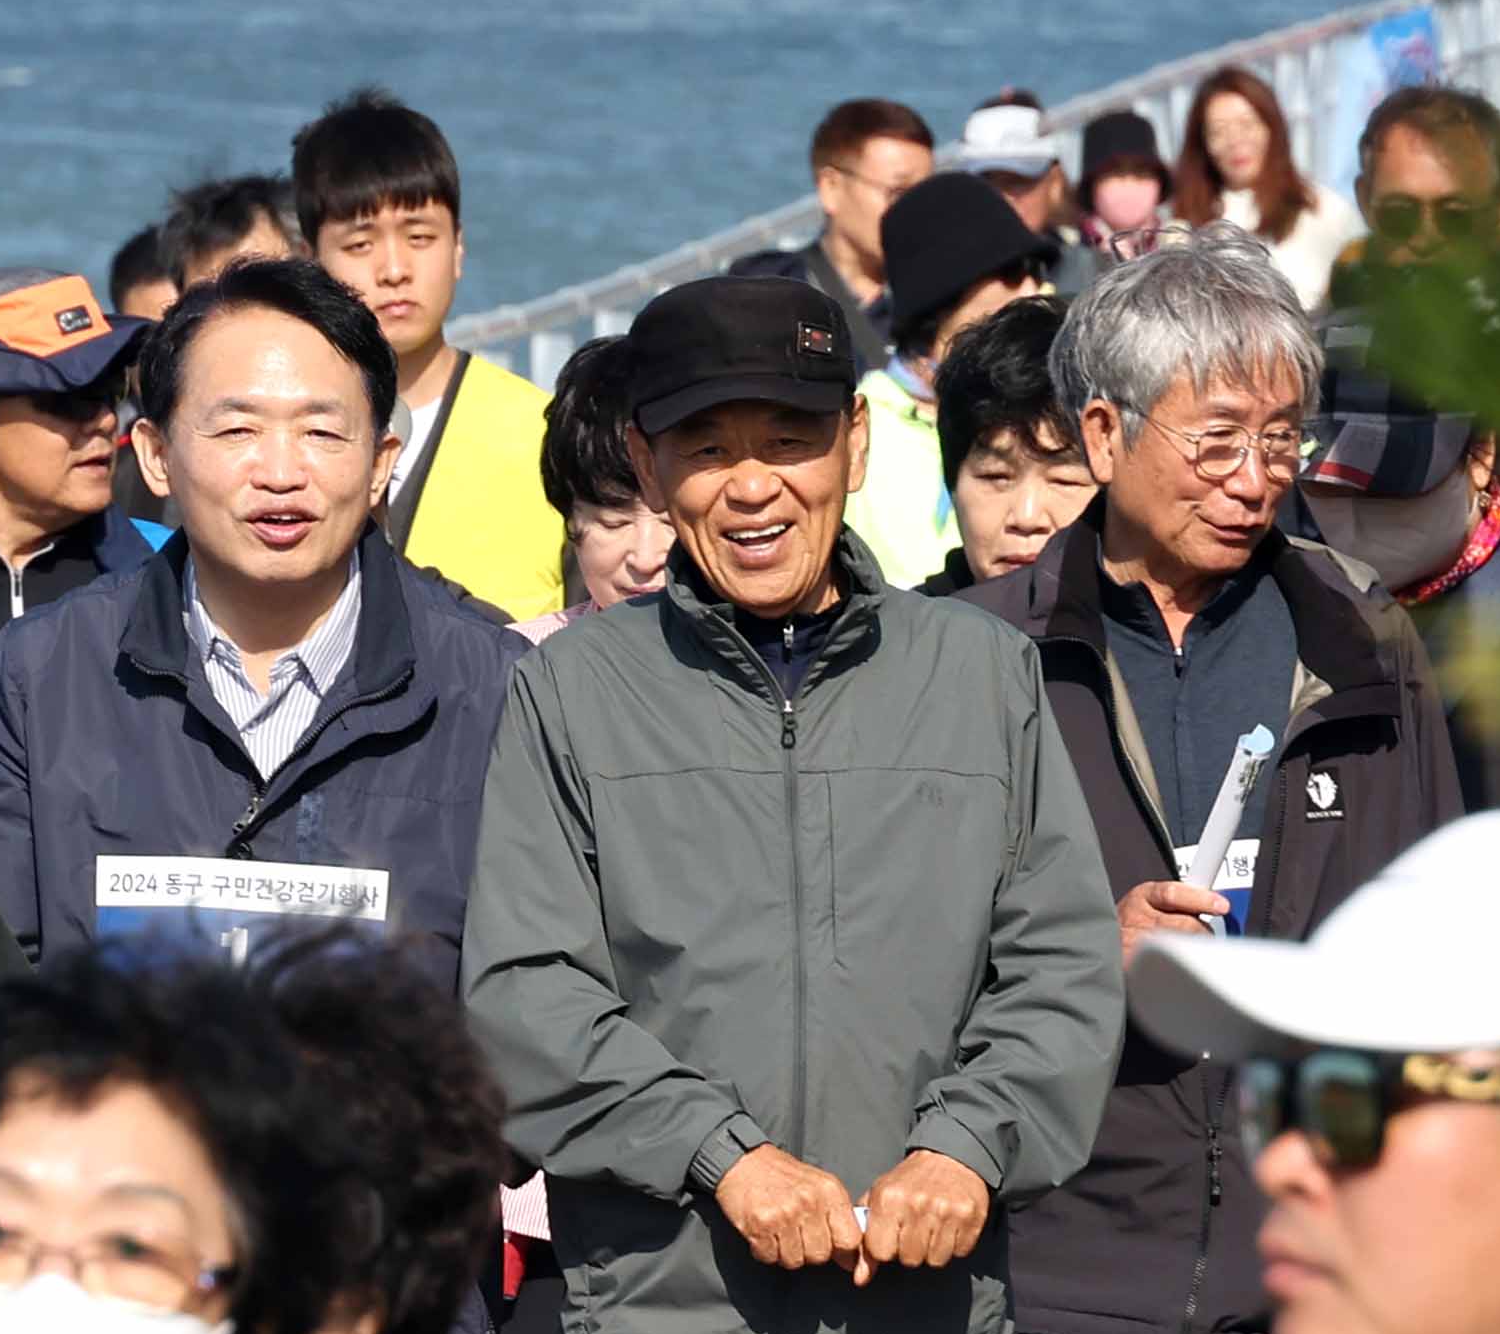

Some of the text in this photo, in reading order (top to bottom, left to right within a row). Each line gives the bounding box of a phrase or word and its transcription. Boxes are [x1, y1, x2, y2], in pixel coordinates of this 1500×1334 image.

[109, 873, 379, 908] 2024 동구 구민건강걷기행사
